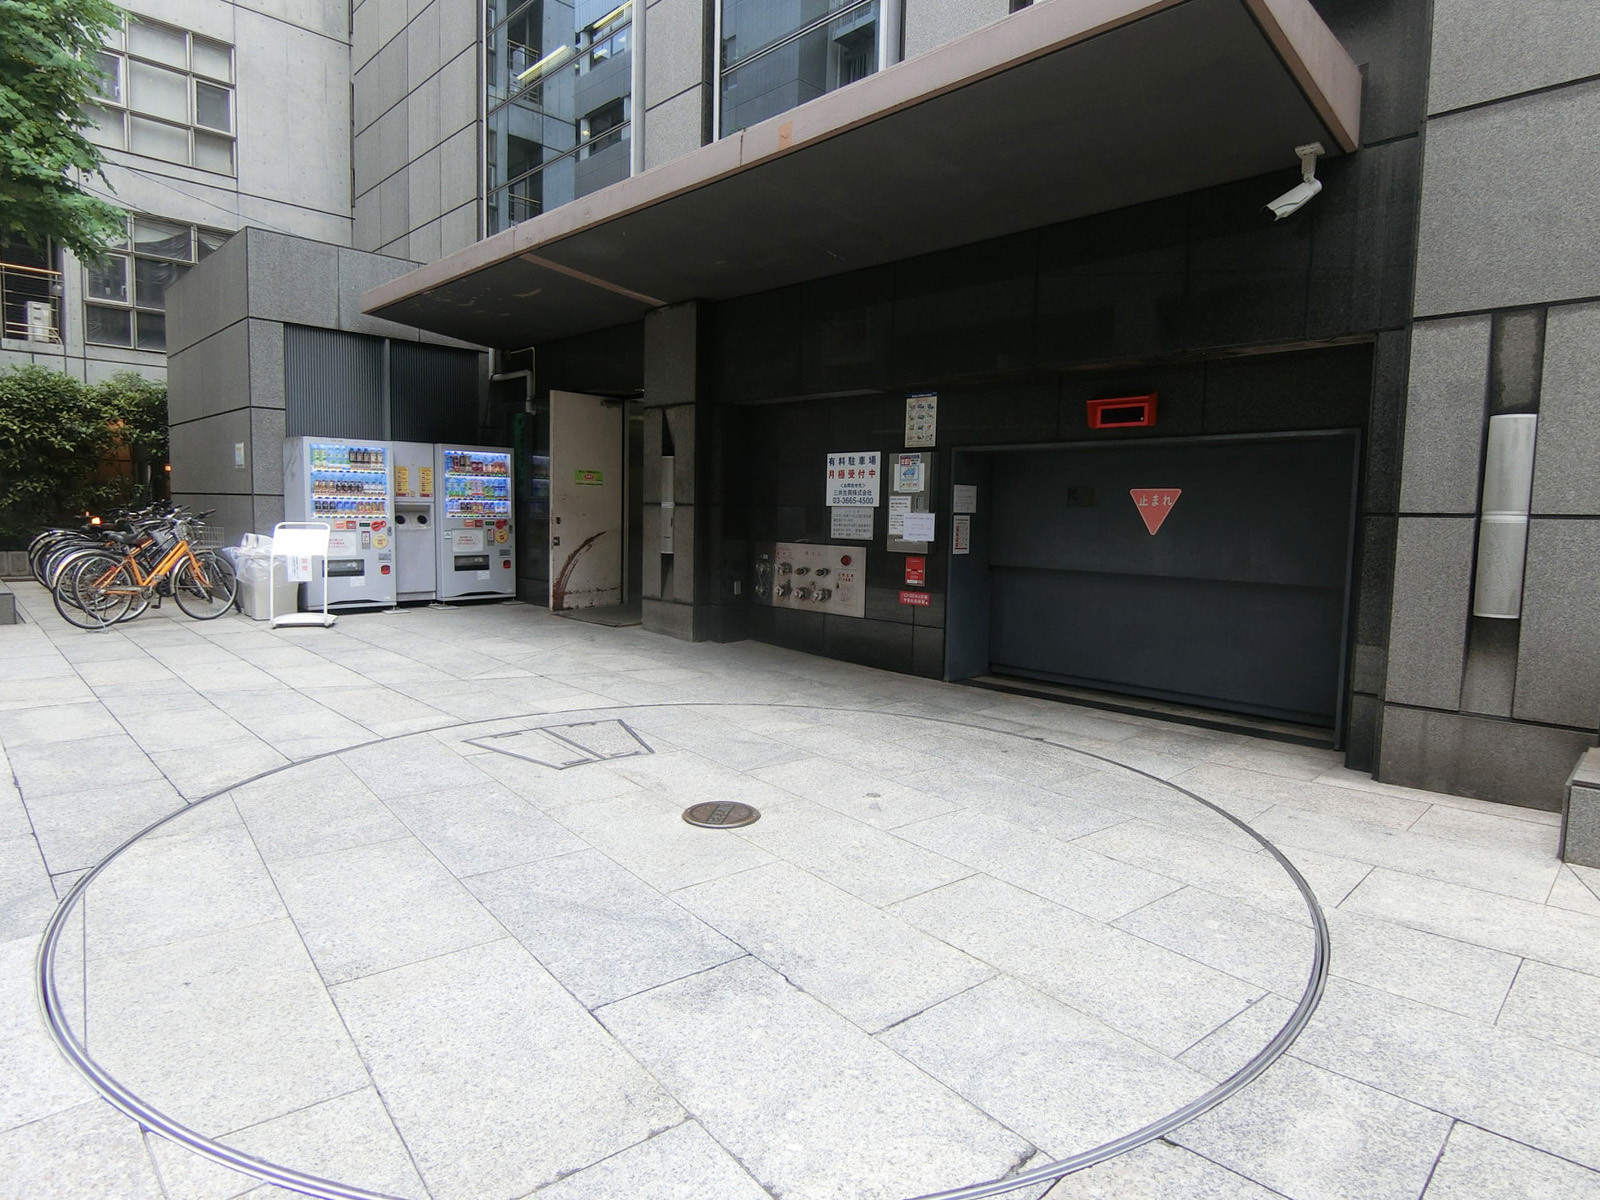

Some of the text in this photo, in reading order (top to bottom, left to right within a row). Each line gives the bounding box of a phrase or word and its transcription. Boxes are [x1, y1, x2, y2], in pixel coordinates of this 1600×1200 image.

[828, 455, 876, 466] 有料駐車場
[828, 469, 876, 479] 月極受付中
[1138, 494, 1173, 507] 止まれ
